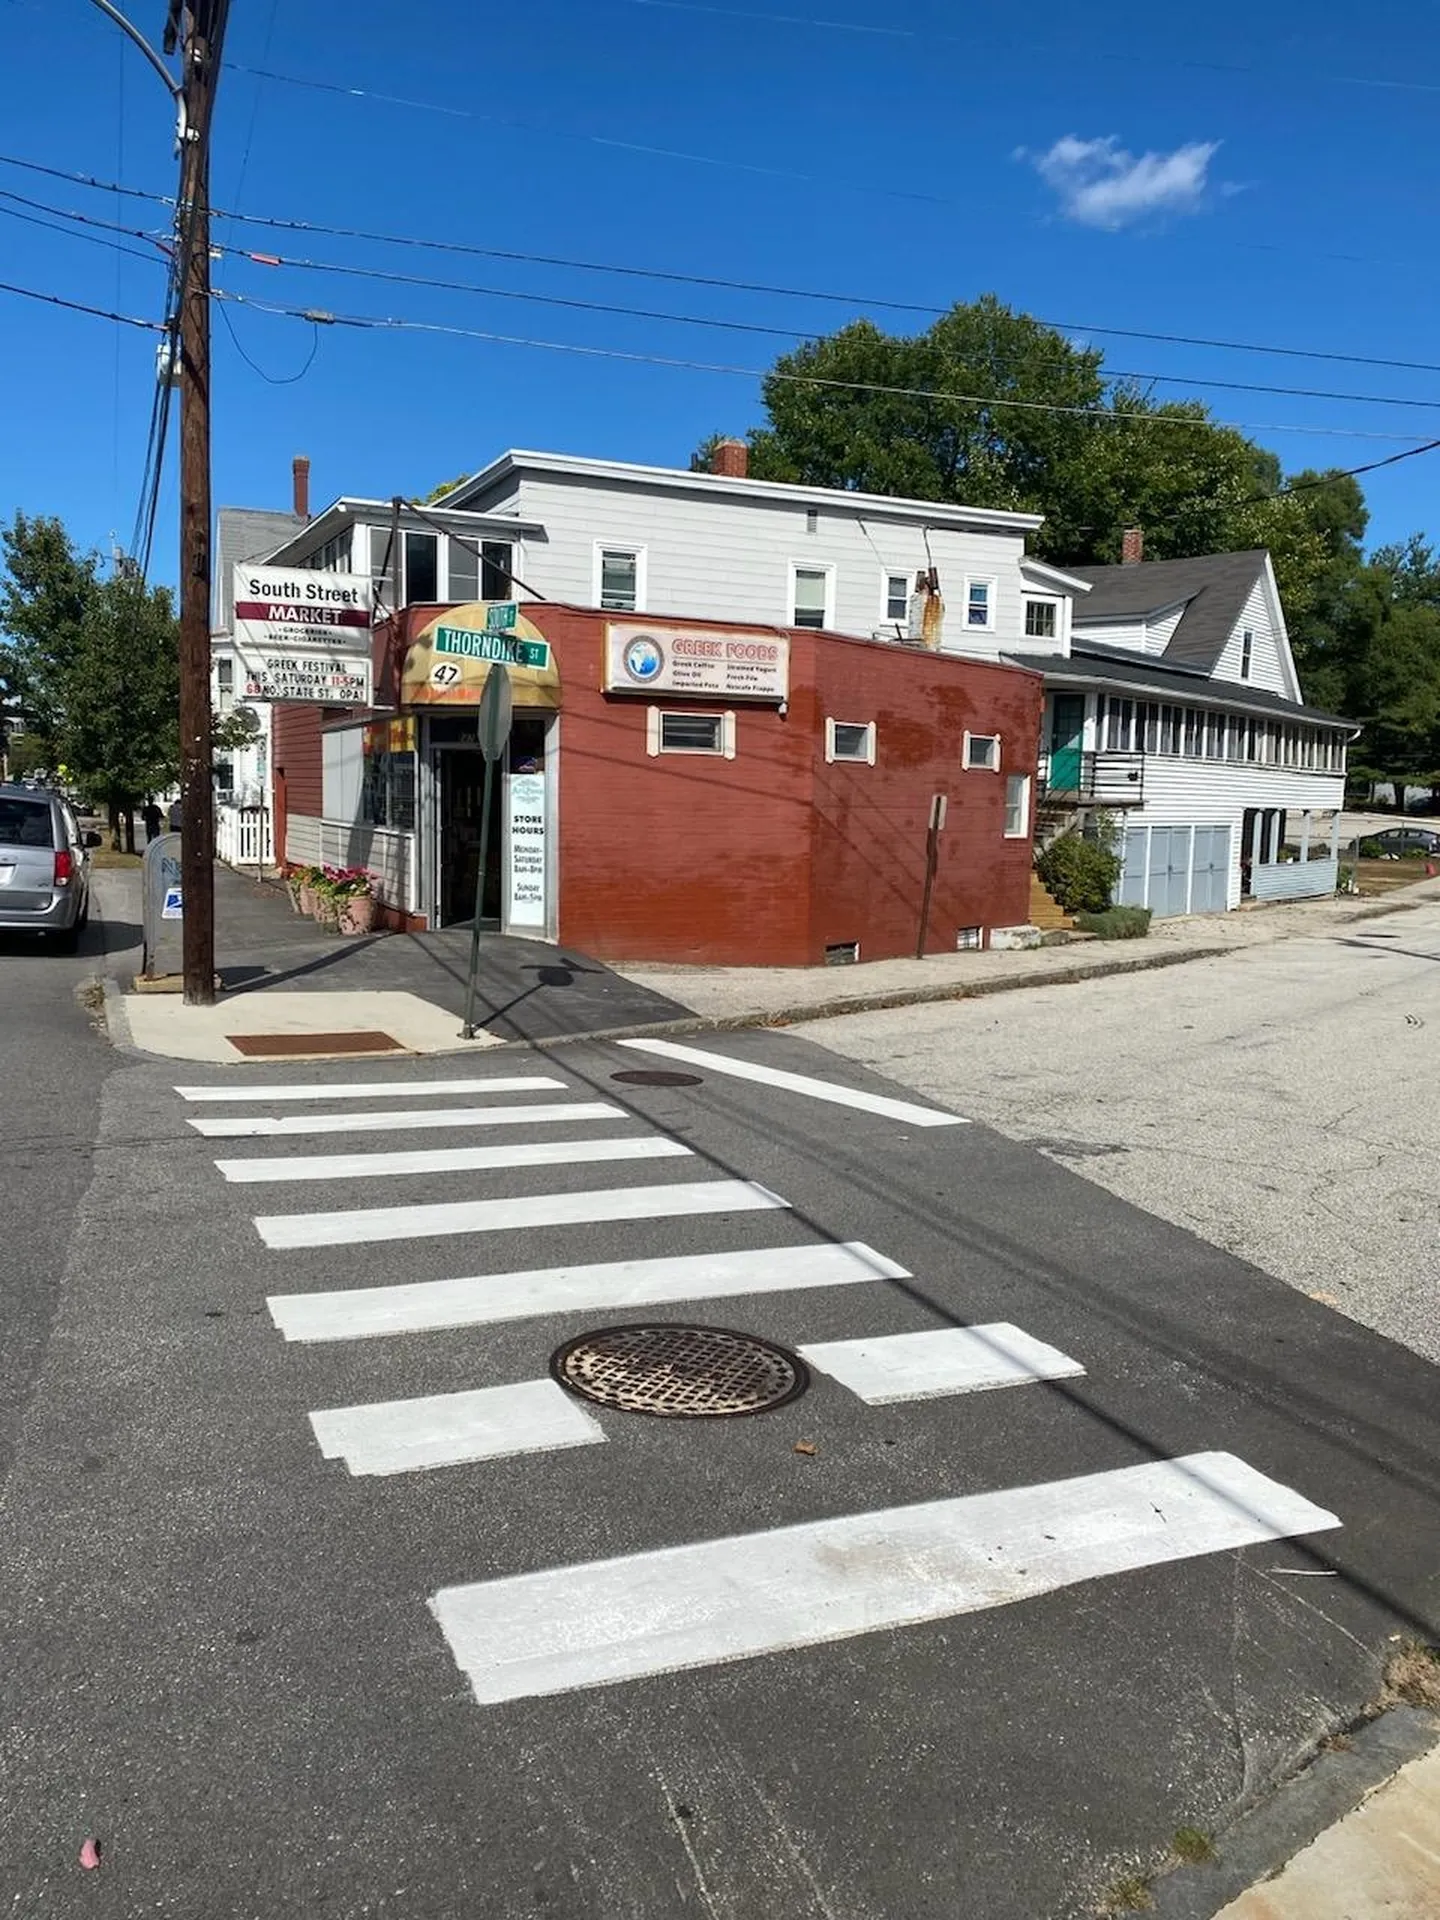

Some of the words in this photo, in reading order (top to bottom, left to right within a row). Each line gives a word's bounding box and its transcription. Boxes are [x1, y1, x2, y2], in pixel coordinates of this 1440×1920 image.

[249, 579, 300, 598] South
[306, 584, 359, 603] Street
[268, 605, 342, 624] MARKET
[444, 630, 524, 663] THORNDIKE
[529, 647, 539, 660] ST
[672, 639, 722, 657] GREEK
[726, 643, 778, 661] FOODS
[266, 658, 298, 670] GREEK
[303, 660, 347, 674] FESTIVAL
[434, 665, 458, 685] 47
[246, 670, 268, 682] THIS
[275, 672, 327, 685] SATURDAY
[332, 676, 364, 687] 11-5PM
[283, 686, 314, 698] STATE
[318, 688, 334, 699] ST.
[340, 689, 364, 700] OPA!
[513, 815, 542, 824] STORE
[511, 826, 544, 835] HOURS
